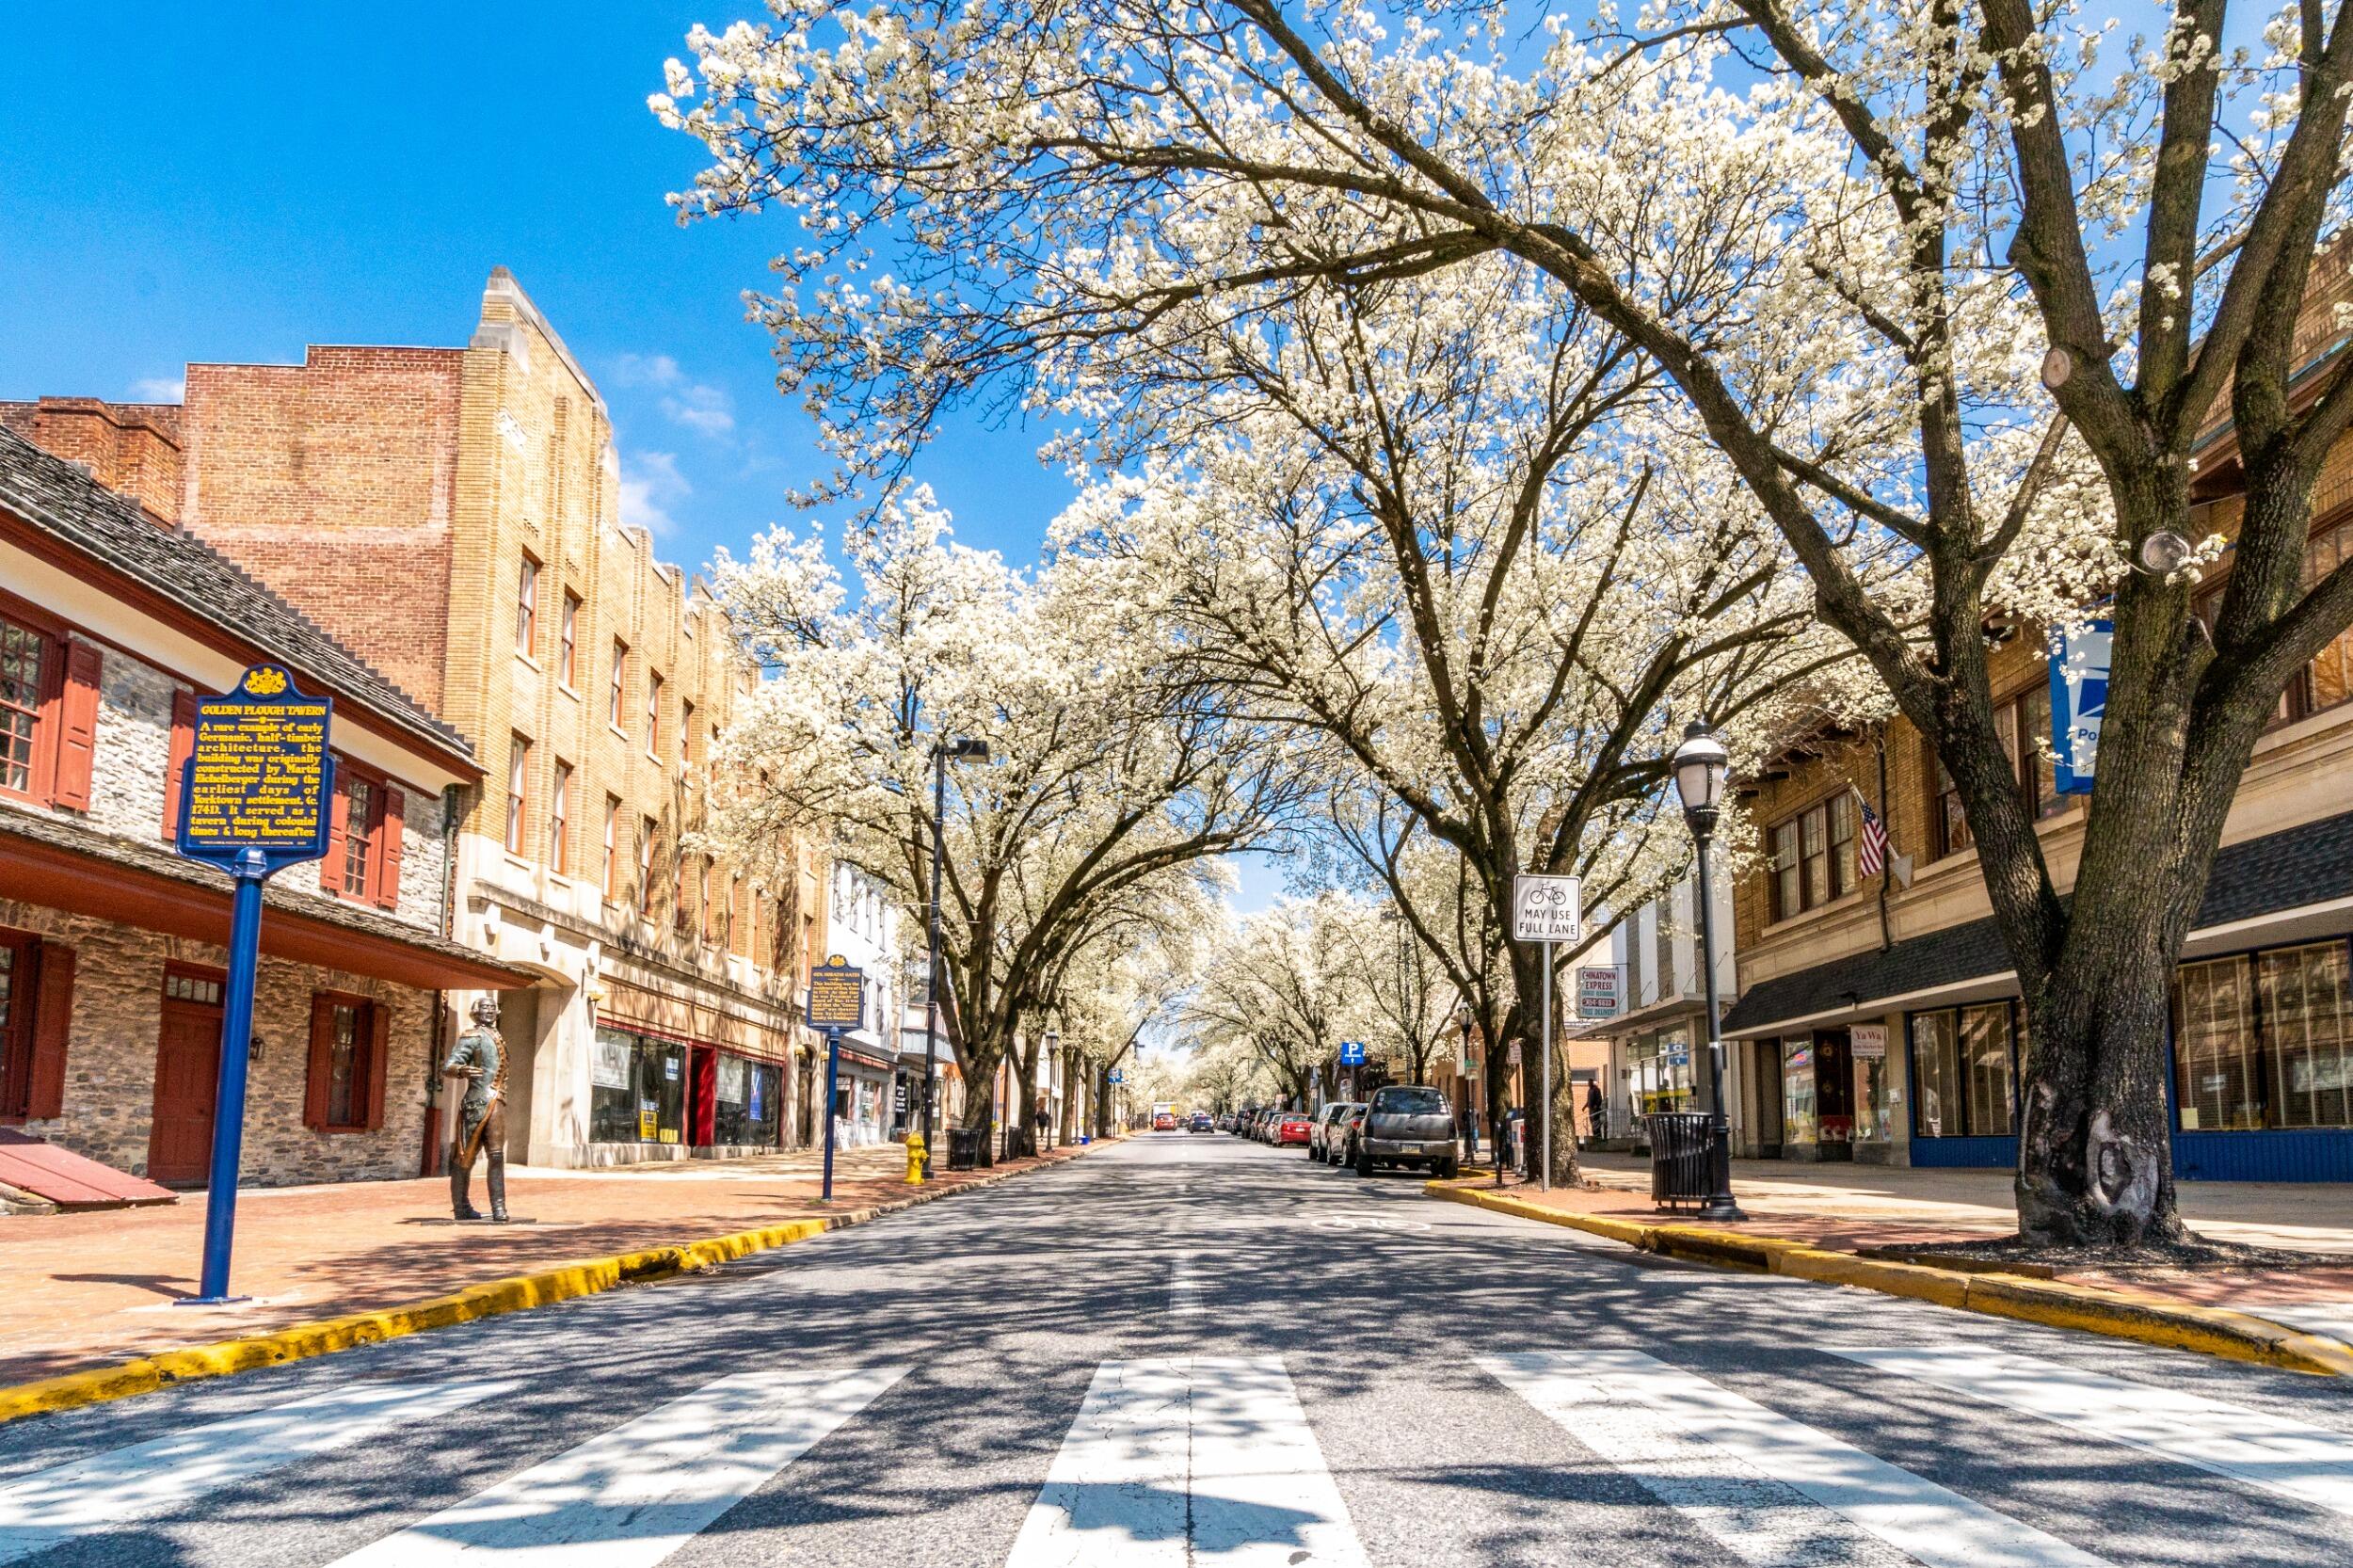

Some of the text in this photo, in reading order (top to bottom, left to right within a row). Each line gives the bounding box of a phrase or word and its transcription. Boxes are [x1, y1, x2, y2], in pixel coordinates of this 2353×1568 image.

[200, 706, 327, 715] GOLDEN PLOUGH TAVERN
[200, 722, 211, 731] A
[237, 723, 280, 733] example
[281, 723, 296, 732] of
[296, 723, 324, 734] early
[257, 733, 324, 743] half-timber
[2078, 728, 2098, 741] Po
[300, 744, 322, 753] the
[197, 752, 241, 764] building
[267, 754, 321, 765] originally
[195, 763, 321, 776] constructed by Martin
[194, 773, 320, 786] Eichelberger during the
[193, 784, 319, 796] earliest days of
[193, 794, 242, 805] Yorktown
[229, 805, 238, 815] It
[245, 806, 284, 815] served
[190, 816, 317, 828] tavern during colonial
[189, 826, 219, 836] times
[222, 826, 231, 837] &
[233, 826, 258, 839] long
[1525, 908, 1571, 920] MAY USE
[1519, 922, 1576, 935] FULL LANE
[1582, 970, 1616, 980] CHINATOWN
[1585, 982, 1612, 990] EXPRESS
[1855, 1031, 1881, 1040] Ya Wa
[1349, 1043, 1358, 1055] P
